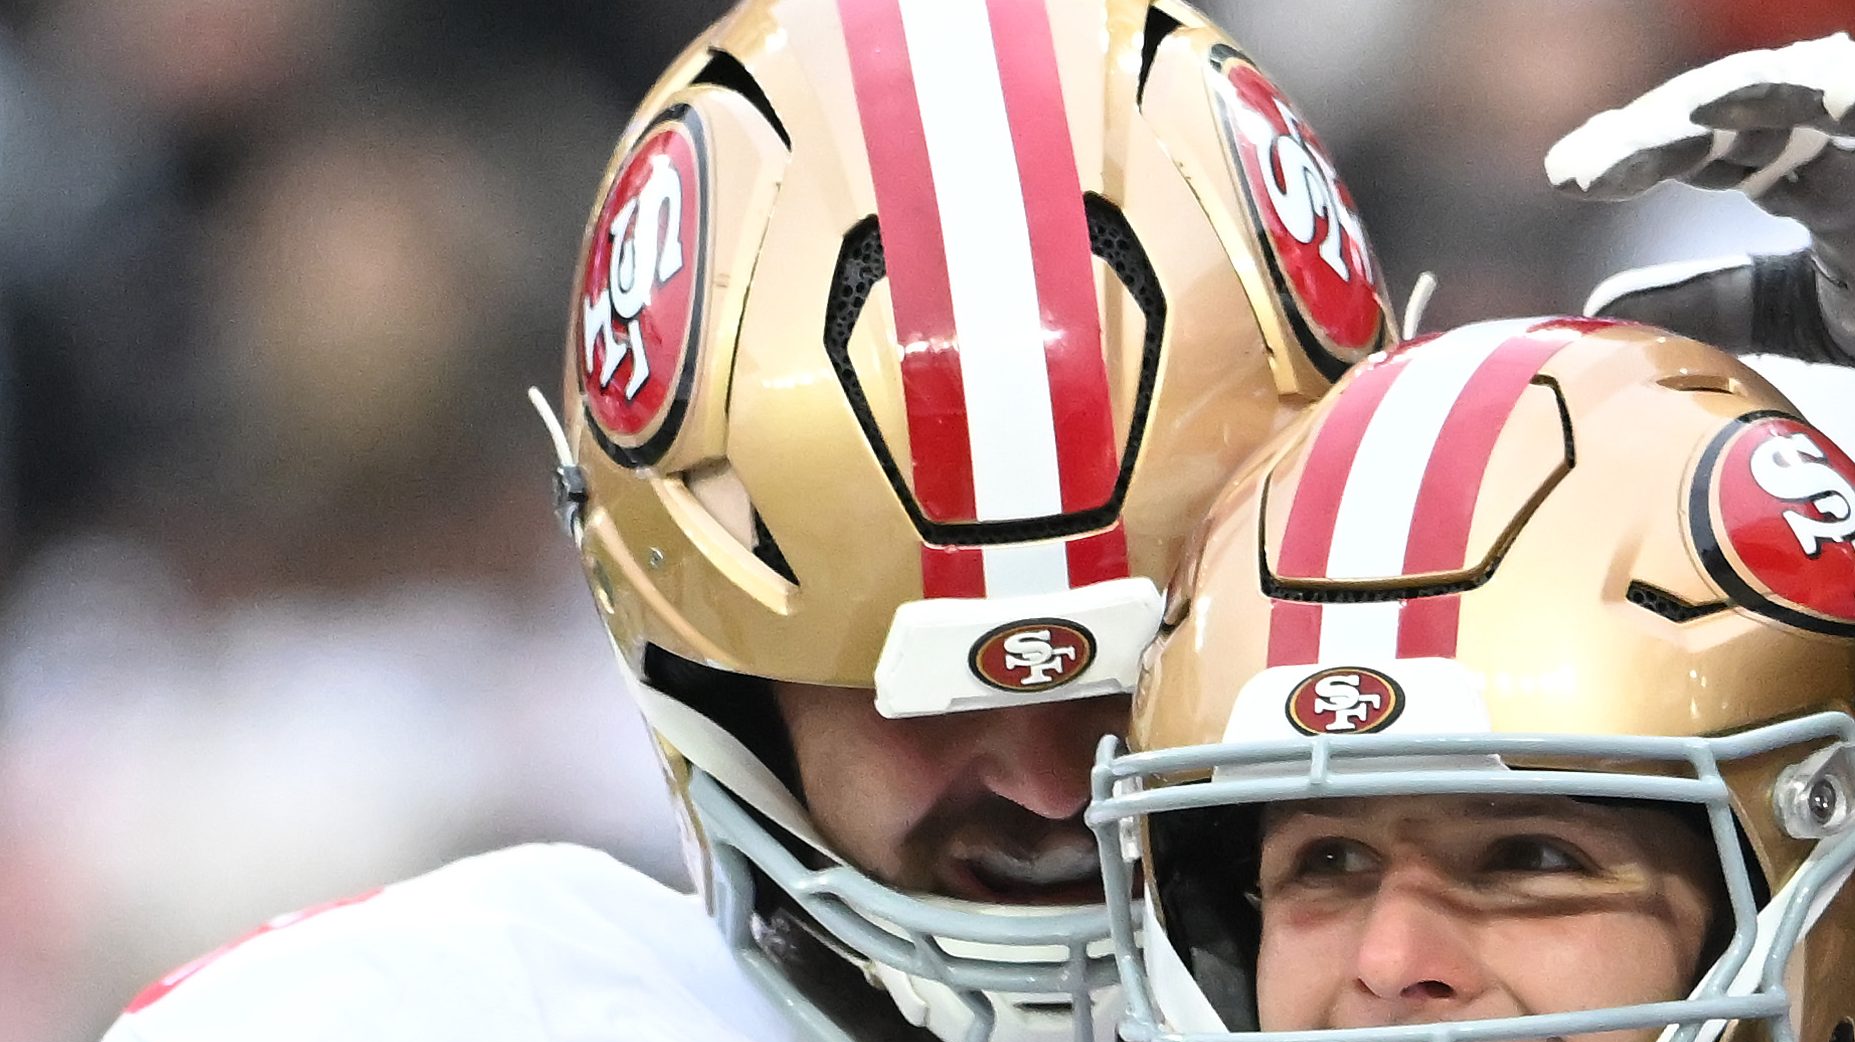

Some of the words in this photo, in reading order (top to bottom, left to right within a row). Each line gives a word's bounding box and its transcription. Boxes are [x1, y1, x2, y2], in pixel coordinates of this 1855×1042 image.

[583, 155, 684, 401] SF
[1003, 629, 1076, 686] SF
[1313, 674, 1382, 731] SF
